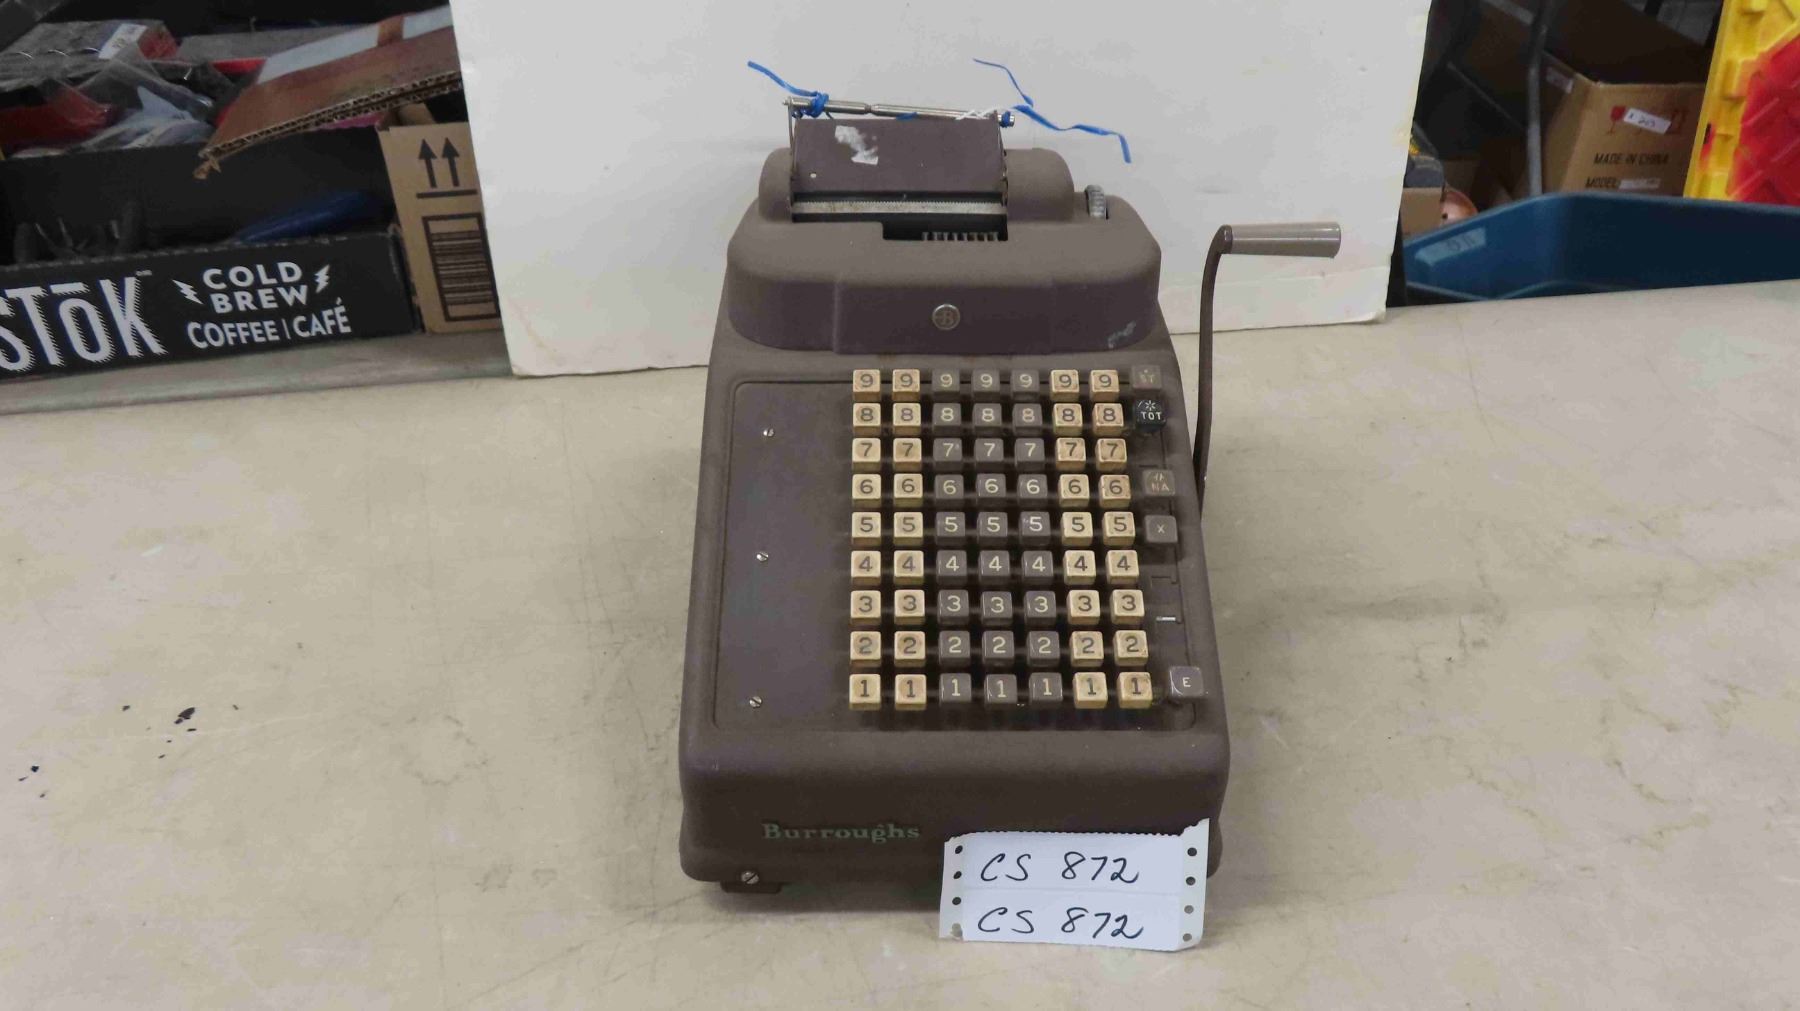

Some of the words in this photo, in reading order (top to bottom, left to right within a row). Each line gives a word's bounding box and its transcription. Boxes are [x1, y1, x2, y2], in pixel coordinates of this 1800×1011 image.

[202, 261, 303, 290] COLD
[210, 284, 308, 314] BREW
[187, 320, 280, 349] COFFEE
[292, 296, 352, 338] CAFÉ
[860, 374, 873, 388] 9
[900, 373, 913, 387] 9
[941, 374, 952, 387] 9
[981, 374, 993, 387] 9
[1020, 374, 1032, 387] 9
[1059, 374, 1071, 388] 9
[1099, 374, 1111, 388] 9
[860, 408, 873, 422] 8
[901, 408, 913, 421] 8
[941, 408, 954, 421] 8
[982, 408, 995, 422] 8
[1022, 408, 1035, 422] 8
[1062, 408, 1075, 422] 8
[1103, 408, 1116, 422] 8
[1140, 411, 1162, 421] TOT
[861, 442, 872, 457] 7
[902, 443, 913, 457] 7
[943, 443, 954, 456] 7
[984, 443, 995, 456] 7
[1025, 443, 1036, 456] 7
[1066, 442, 1077, 456] 7
[1107, 443, 1118, 457] 7
[860, 479, 873, 494] 6
[902, 479, 915, 493] 6
[943, 480, 956, 494] 6
[985, 479, 998, 493] 6
[1027, 479, 1039, 494] 6
[1069, 479, 1081, 494] 6
[1109, 479, 1122, 494] 6
[860, 517, 873, 532] 5
[902, 517, 915, 532] 5
[945, 517, 958, 532] 5
[988, 517, 1000, 532] 5
[1030, 517, 1042, 531] 5
[1072, 517, 1085, 532] 5
[1114, 517, 1127, 532] 5
[859, 556, 872, 572] 4
[902, 556, 915, 571] 4
[946, 556, 959, 571] 4
[989, 556, 1002, 571] 4
[1032, 557, 1045, 571] 4
[1074, 556, 1087, 571] 4
[1117, 556, 1130, 571] 4
[859, 596, 872, 612] 3
[903, 595, 916, 611] 3
[947, 596, 961, 611] 3
[991, 597, 1004, 613] 3
[1035, 596, 1048, 612] 3
[1078, 595, 1092, 611] 3
[1122, 594, 1136, 611] 3
[859, 637, 872, 654] 2
[903, 637, 916, 654] 2
[949, 637, 961, 653] 2
[993, 637, 1005, 653] 2
[1038, 637, 1051, 653] 2
[1079, 637, 1094, 654] 2
[1126, 635, 1139, 652] 2
[859, 680, 870, 697] 1
[906, 680, 916, 698] 1
[951, 679, 961, 696] 1
[996, 680, 1007, 697] 1
[1042, 678, 1053, 695] 1
[1085, 678, 1097, 695] 1
[1130, 677, 1142, 695] 1
[1182, 676, 1191, 688] E
[761, 823, 920, 844] Burroughs
[980, 853, 1031, 882] CS
[1061, 851, 1140, 883] 872
[977, 907, 1034, 934] CS
[1061, 907, 1144, 939] 872
